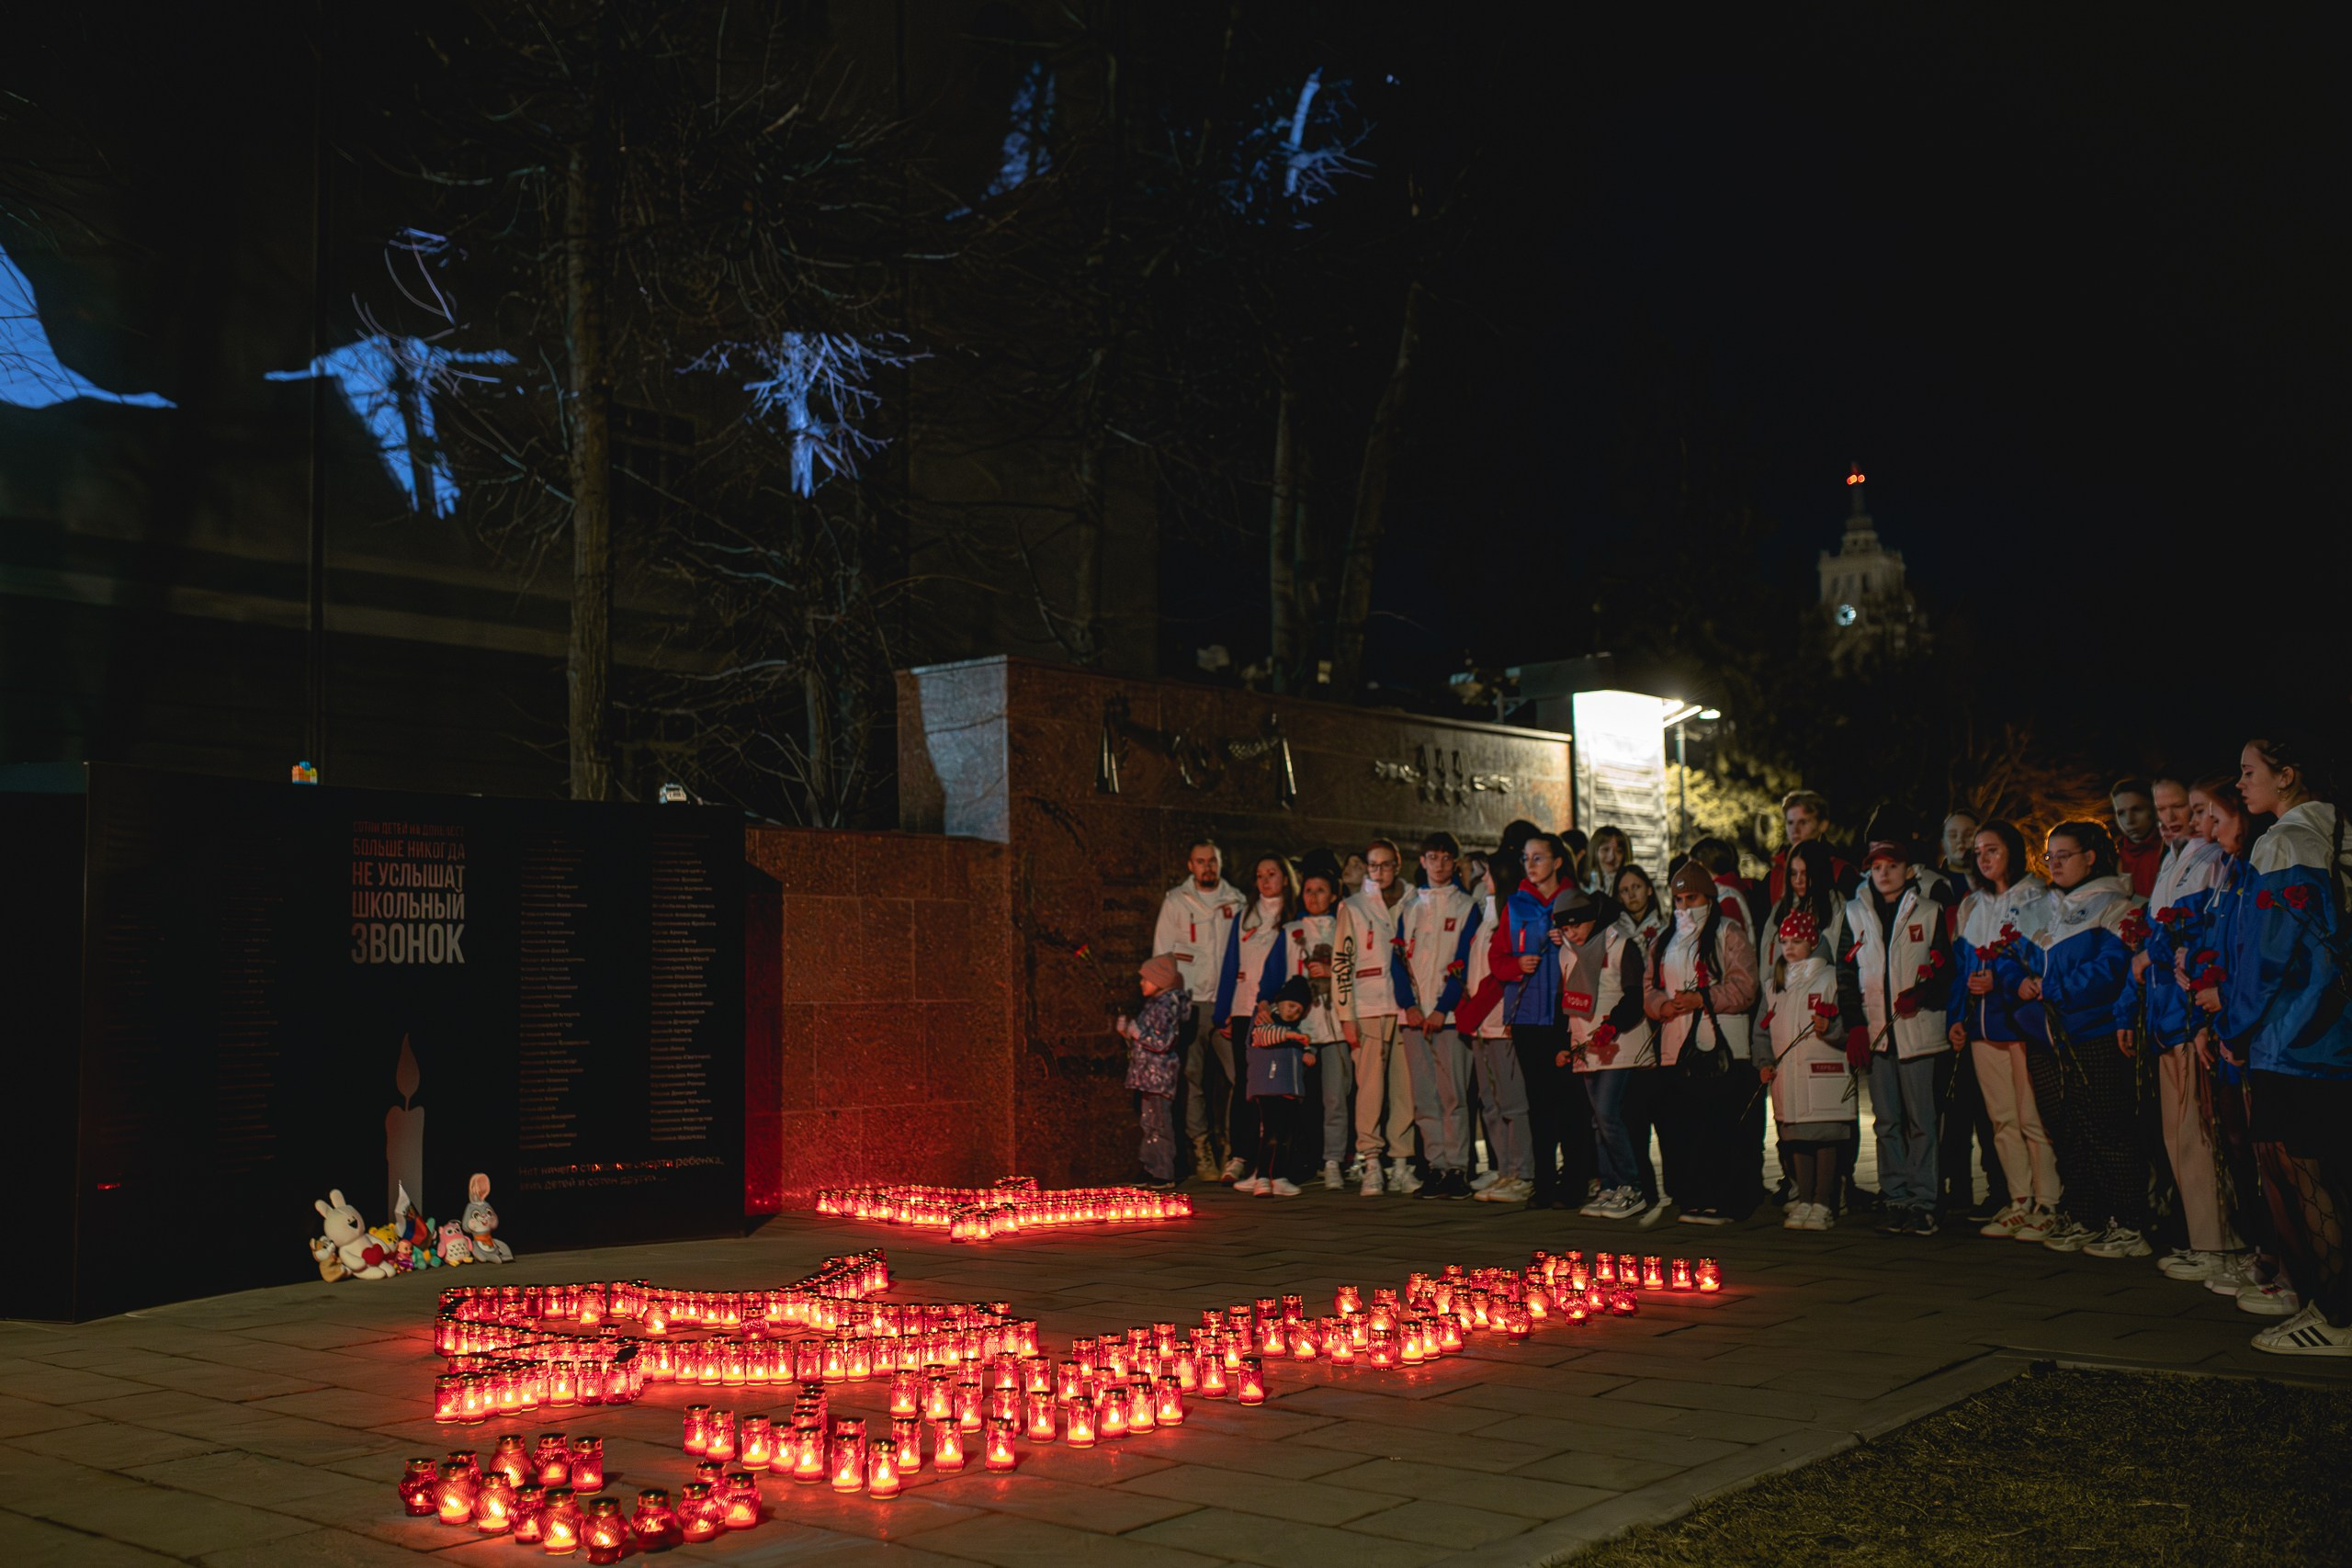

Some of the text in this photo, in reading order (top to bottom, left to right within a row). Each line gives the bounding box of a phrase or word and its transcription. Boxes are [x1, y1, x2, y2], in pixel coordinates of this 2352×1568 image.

[381, 821, 408, 835] ДЕТЕЙ
[353, 837, 466, 862] БОЛЬШЕ НИКОГДА
[352, 862, 466, 889] НЕ УСЛЫШАТ
[352, 887, 466, 919] ШКОЛЬНЫЙ
[351, 922, 466, 964] ЗВОНОК
